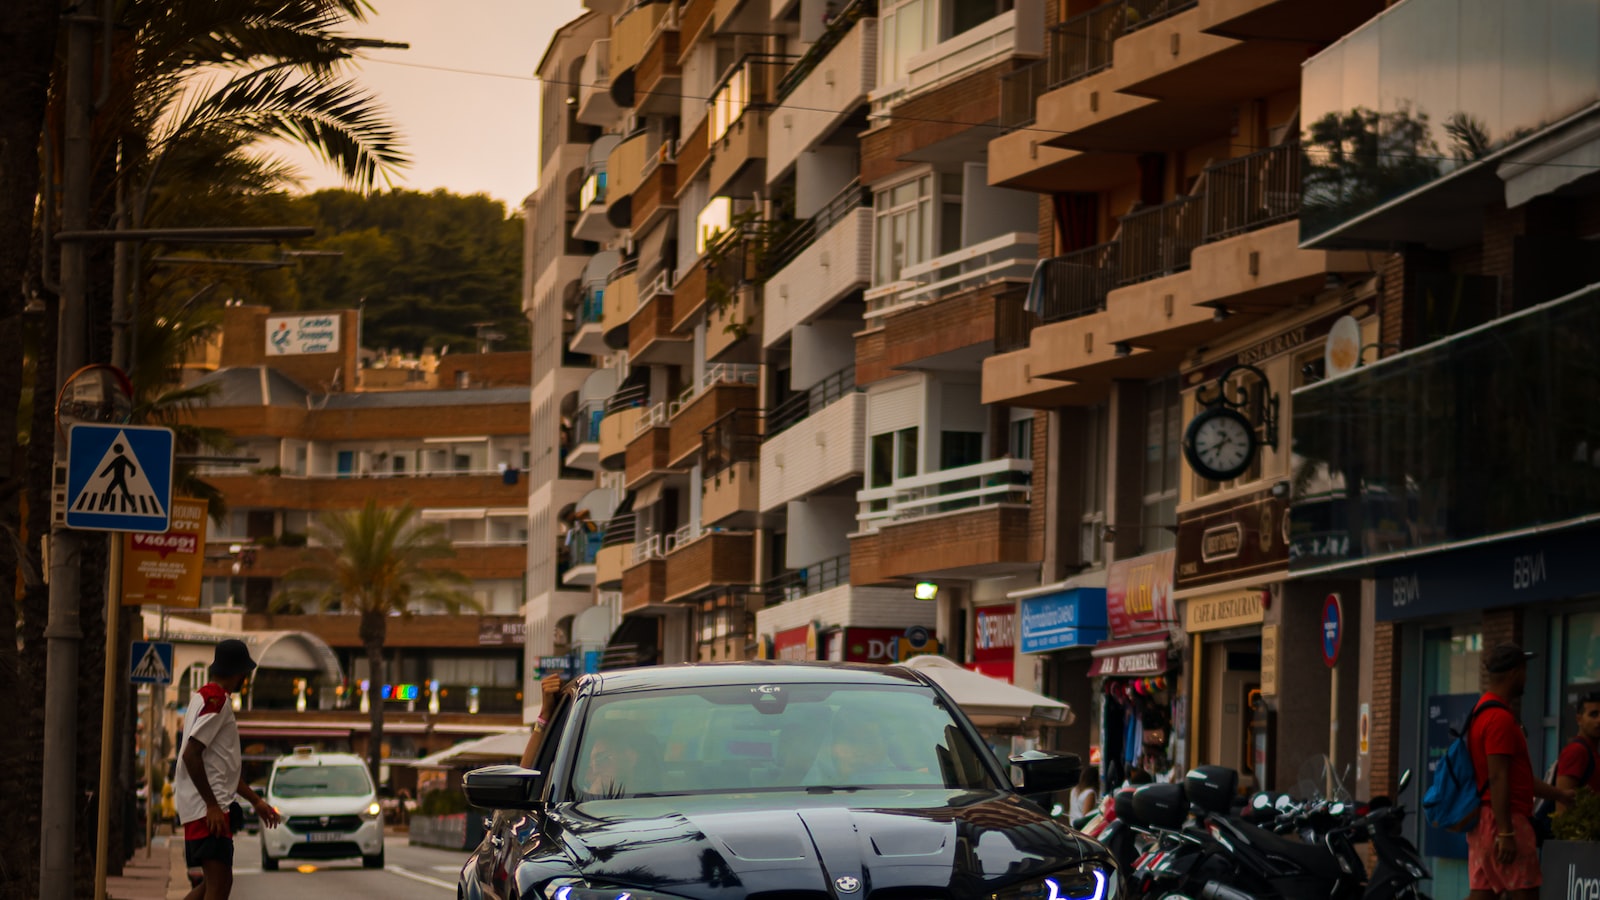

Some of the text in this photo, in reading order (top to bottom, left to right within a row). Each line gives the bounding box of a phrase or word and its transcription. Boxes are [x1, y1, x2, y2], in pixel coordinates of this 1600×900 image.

[1236, 328, 1307, 366] RESTAURANT
[1513, 549, 1546, 589] BBVA
[1392, 571, 1420, 607] BBVA
[1218, 595, 1262, 620] RESTAURANT
[540, 657, 570, 669] HOSTAL
[1567, 863, 1600, 900] llore
